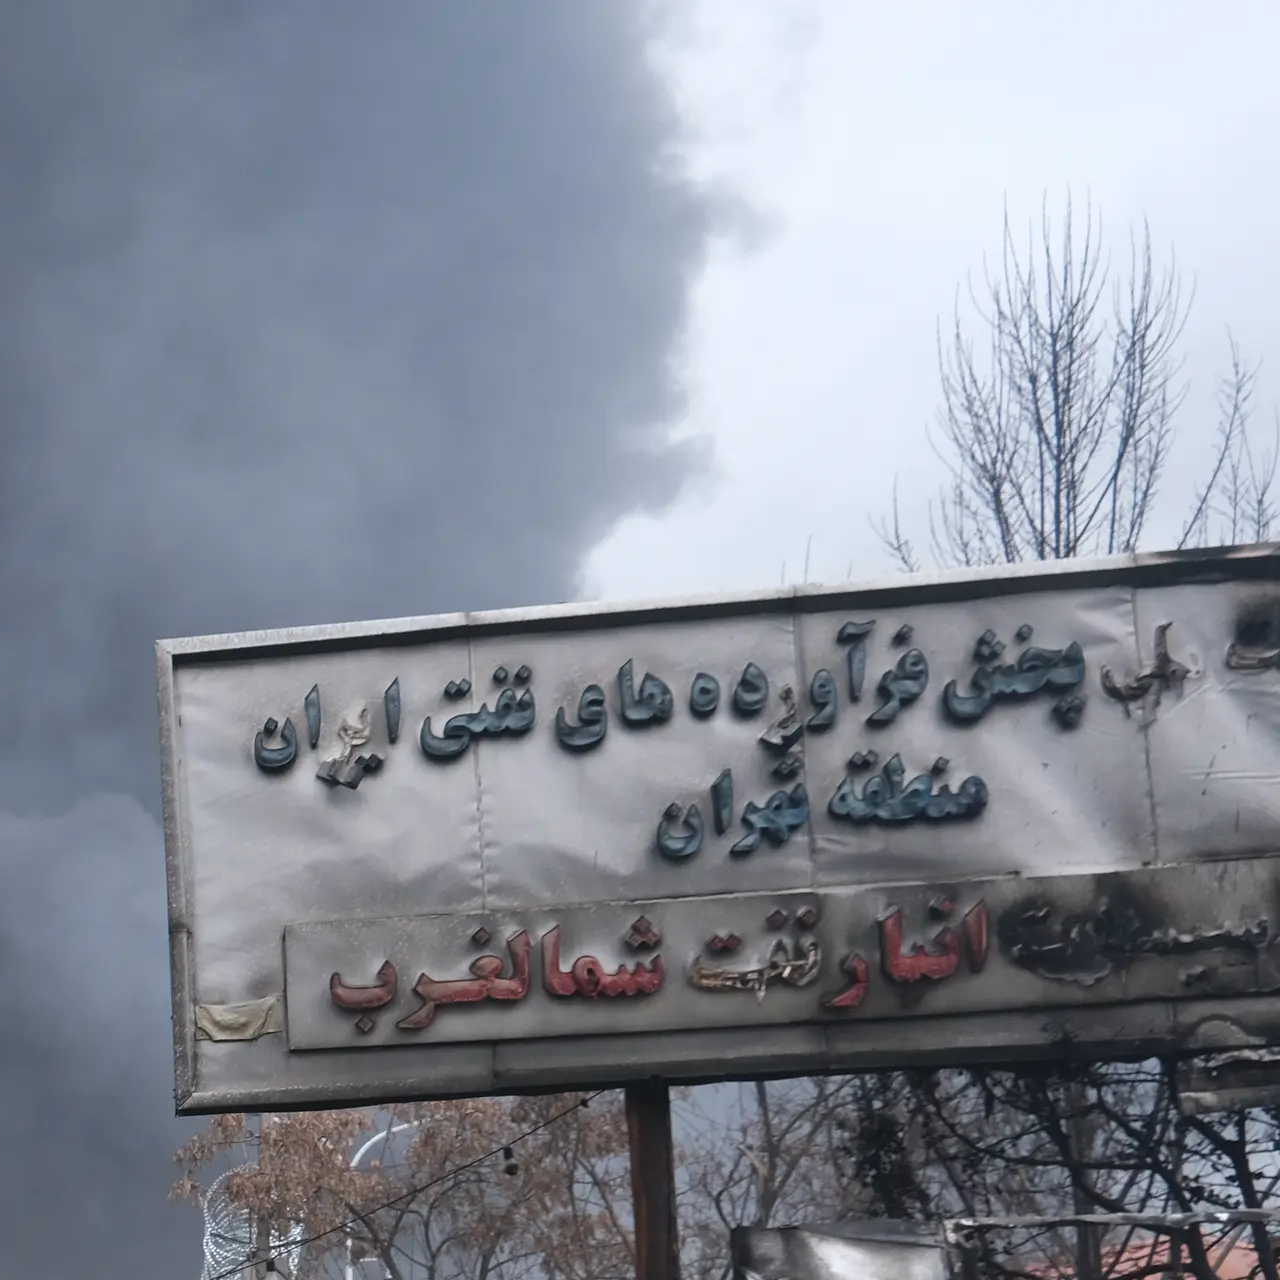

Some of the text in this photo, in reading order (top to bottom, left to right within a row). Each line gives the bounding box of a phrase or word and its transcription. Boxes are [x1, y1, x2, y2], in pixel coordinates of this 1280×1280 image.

[420, 664, 536, 762] نفتی
[943, 623, 1086, 731] پخش
[253, 676, 402, 790] ایران
[655, 748, 989, 859] منطقه تهران
[690, 907, 822, 1002] نفت
